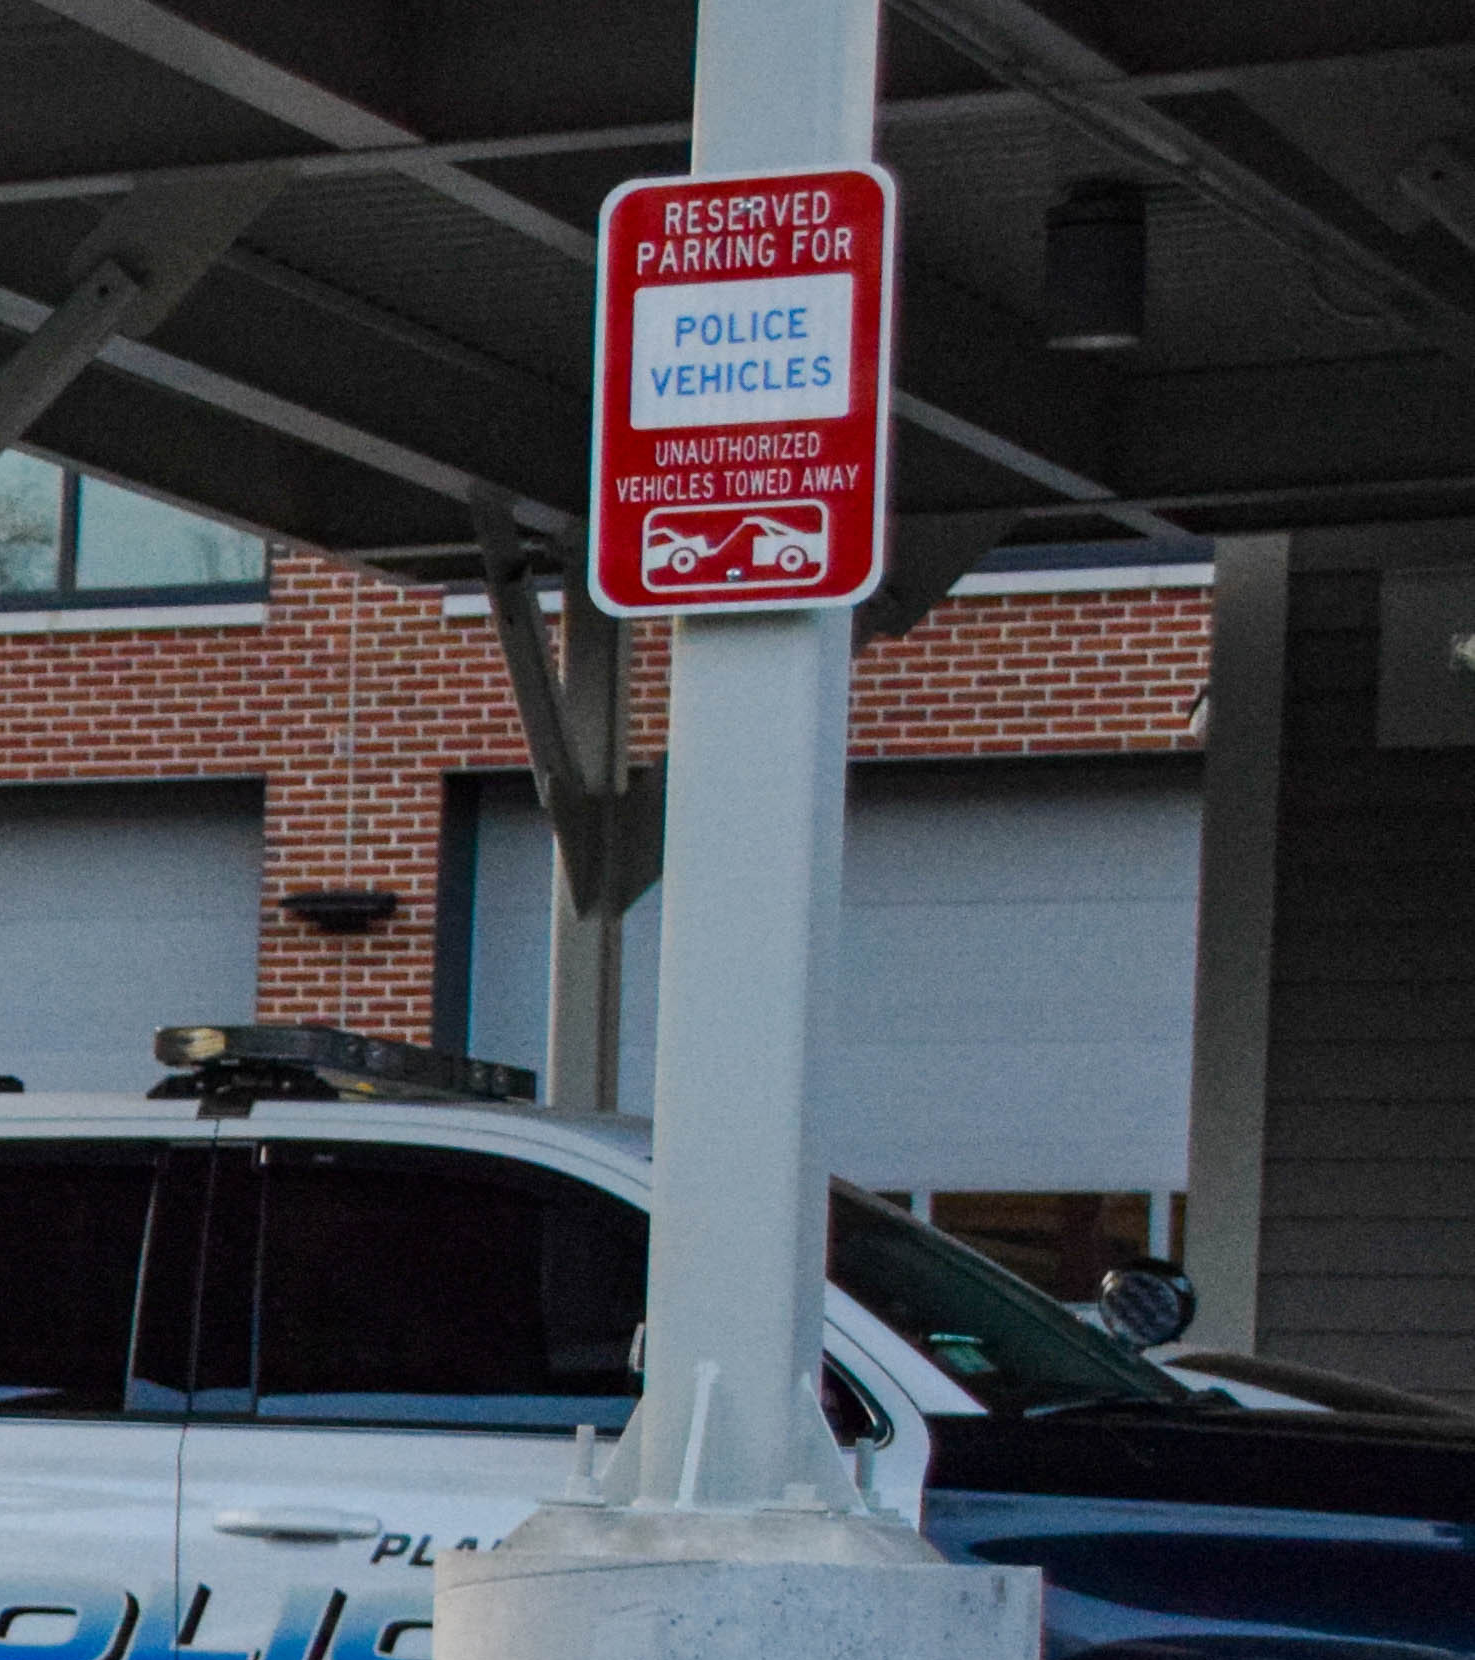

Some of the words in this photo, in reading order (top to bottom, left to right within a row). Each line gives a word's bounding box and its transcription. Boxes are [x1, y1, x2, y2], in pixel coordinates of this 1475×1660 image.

[664, 190, 831, 236] RESERVED
[636, 232, 776, 275] PARKING
[791, 228, 853, 265] FOR
[675, 307, 809, 347] POLICE
[650, 355, 833, 398] VEHICLES
[654, 431, 821, 467] UNAUTHORIZED
[615, 472, 714, 503] VEHICLES
[723, 467, 792, 497] TOWED
[800, 464, 859, 492] AWAY
